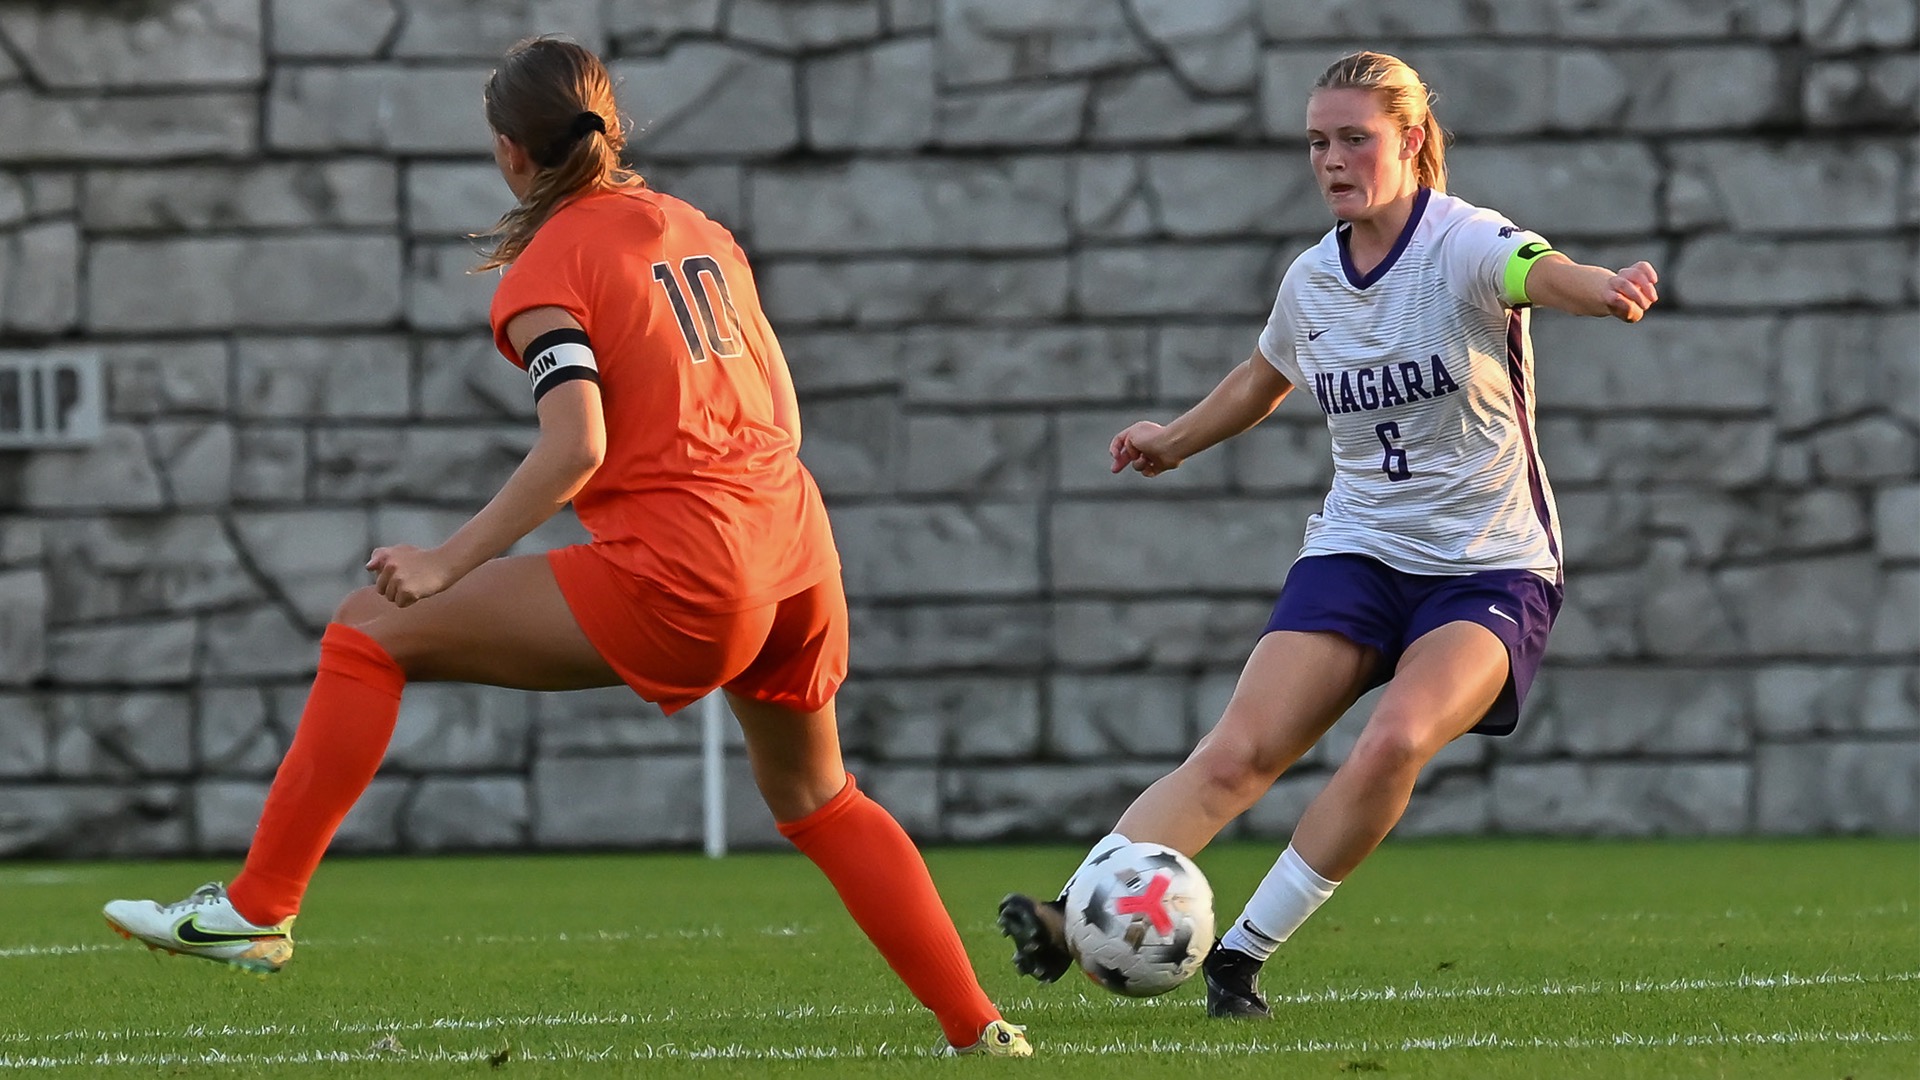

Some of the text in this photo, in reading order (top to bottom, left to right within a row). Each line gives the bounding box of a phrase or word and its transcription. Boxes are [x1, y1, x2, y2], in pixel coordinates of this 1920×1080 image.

[652, 255, 743, 364] 10
[1314, 354, 1460, 415] NIAGARA
[1375, 421, 1413, 482] 6
